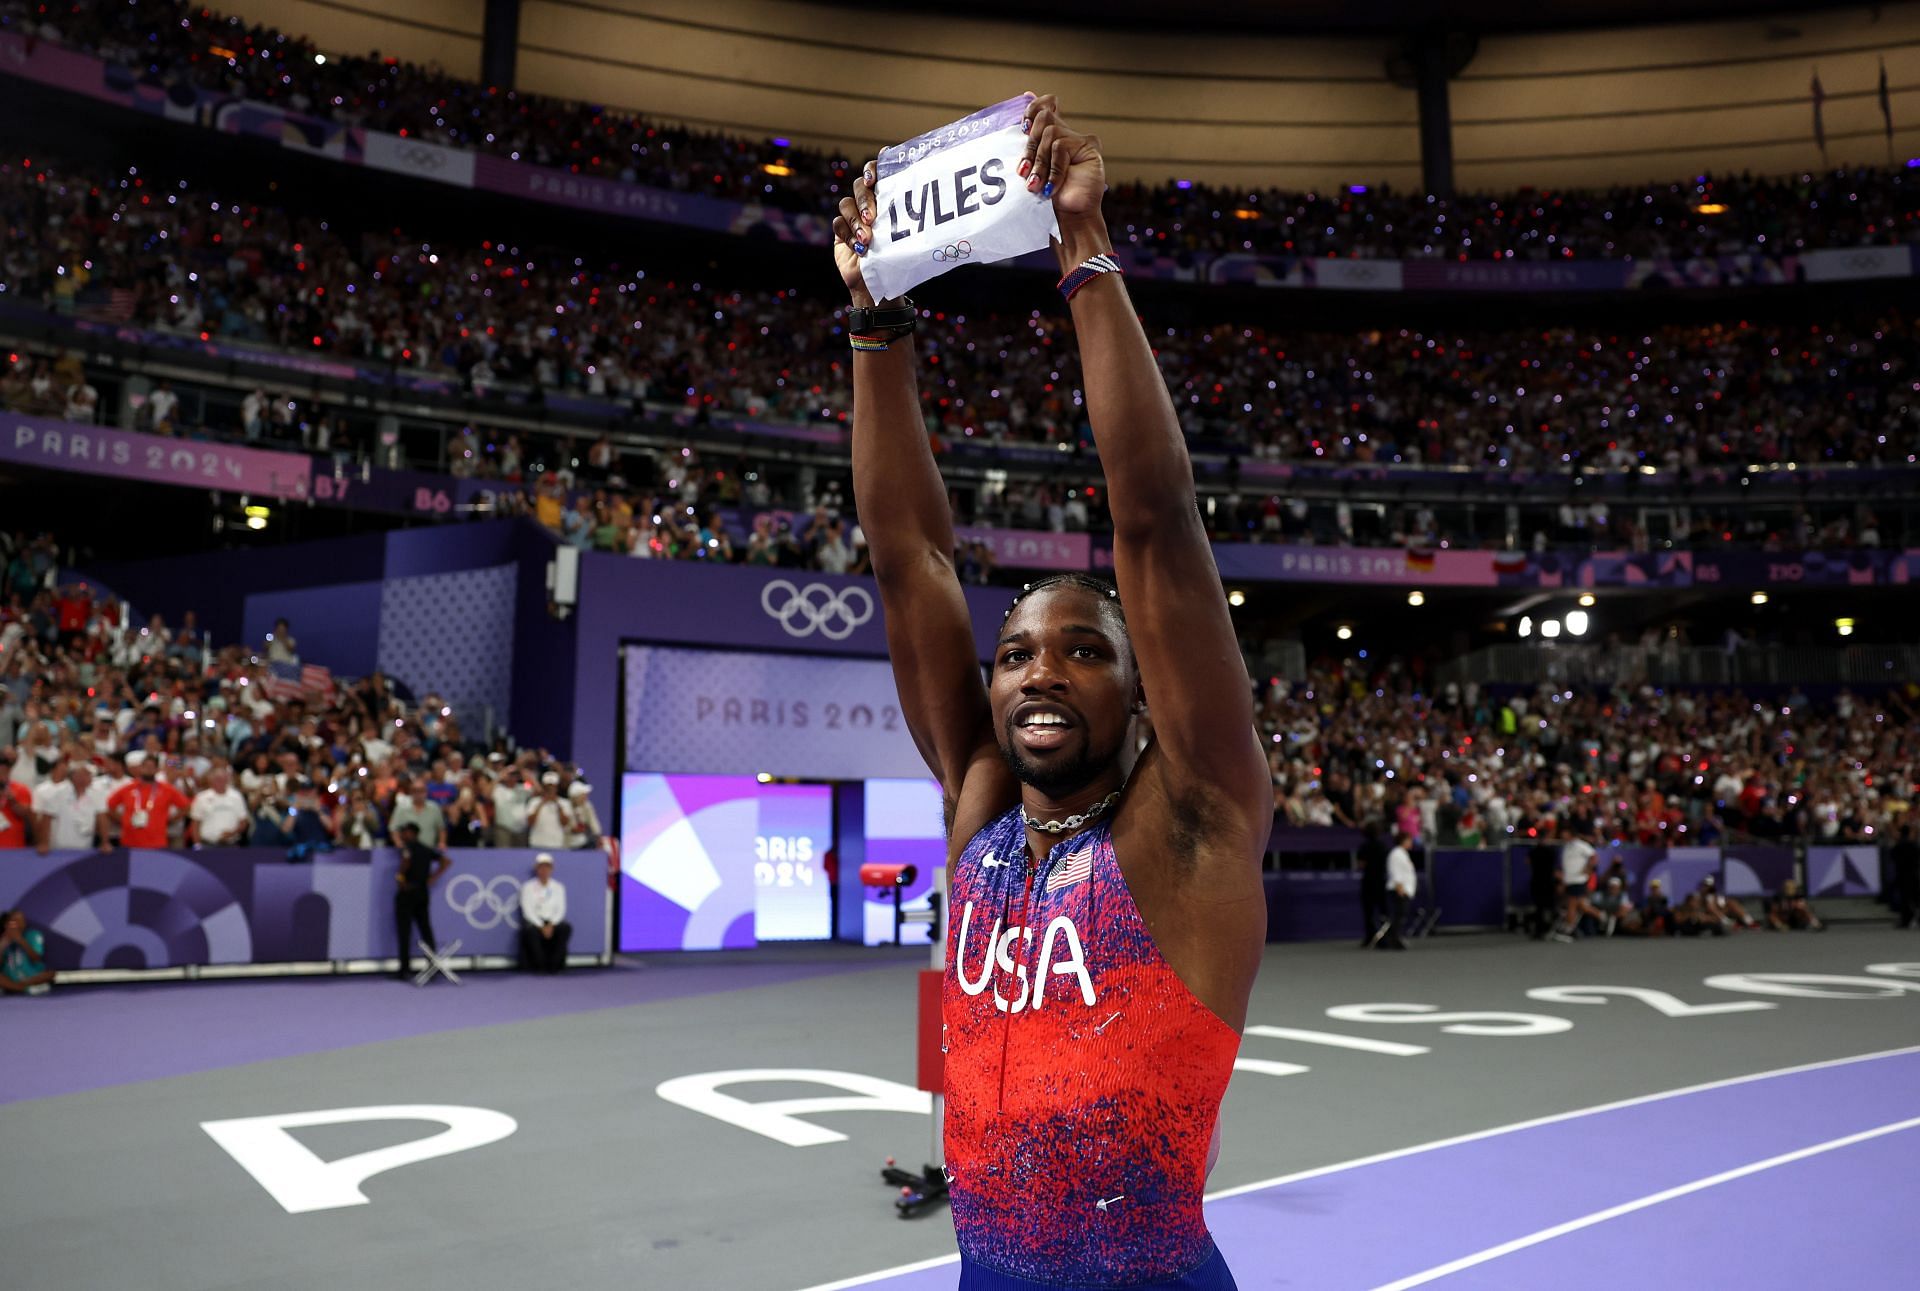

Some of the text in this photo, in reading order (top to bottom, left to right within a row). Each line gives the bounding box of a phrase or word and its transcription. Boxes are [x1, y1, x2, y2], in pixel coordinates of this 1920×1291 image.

[898, 117, 990, 163] PARIS 2024
[529, 173, 603, 203] PARIS
[888, 158, 1007, 243] LYLES
[15, 425, 243, 479] PARIS 2024
[414, 486, 451, 514] B6
[1004, 537, 1072, 561] 2024
[1282, 552, 1408, 578] PARIS 202
[696, 696, 900, 732] PARIS 202
[754, 836, 813, 862] ARIS
[754, 862, 813, 888] 024
[957, 901, 1097, 1014] USA
